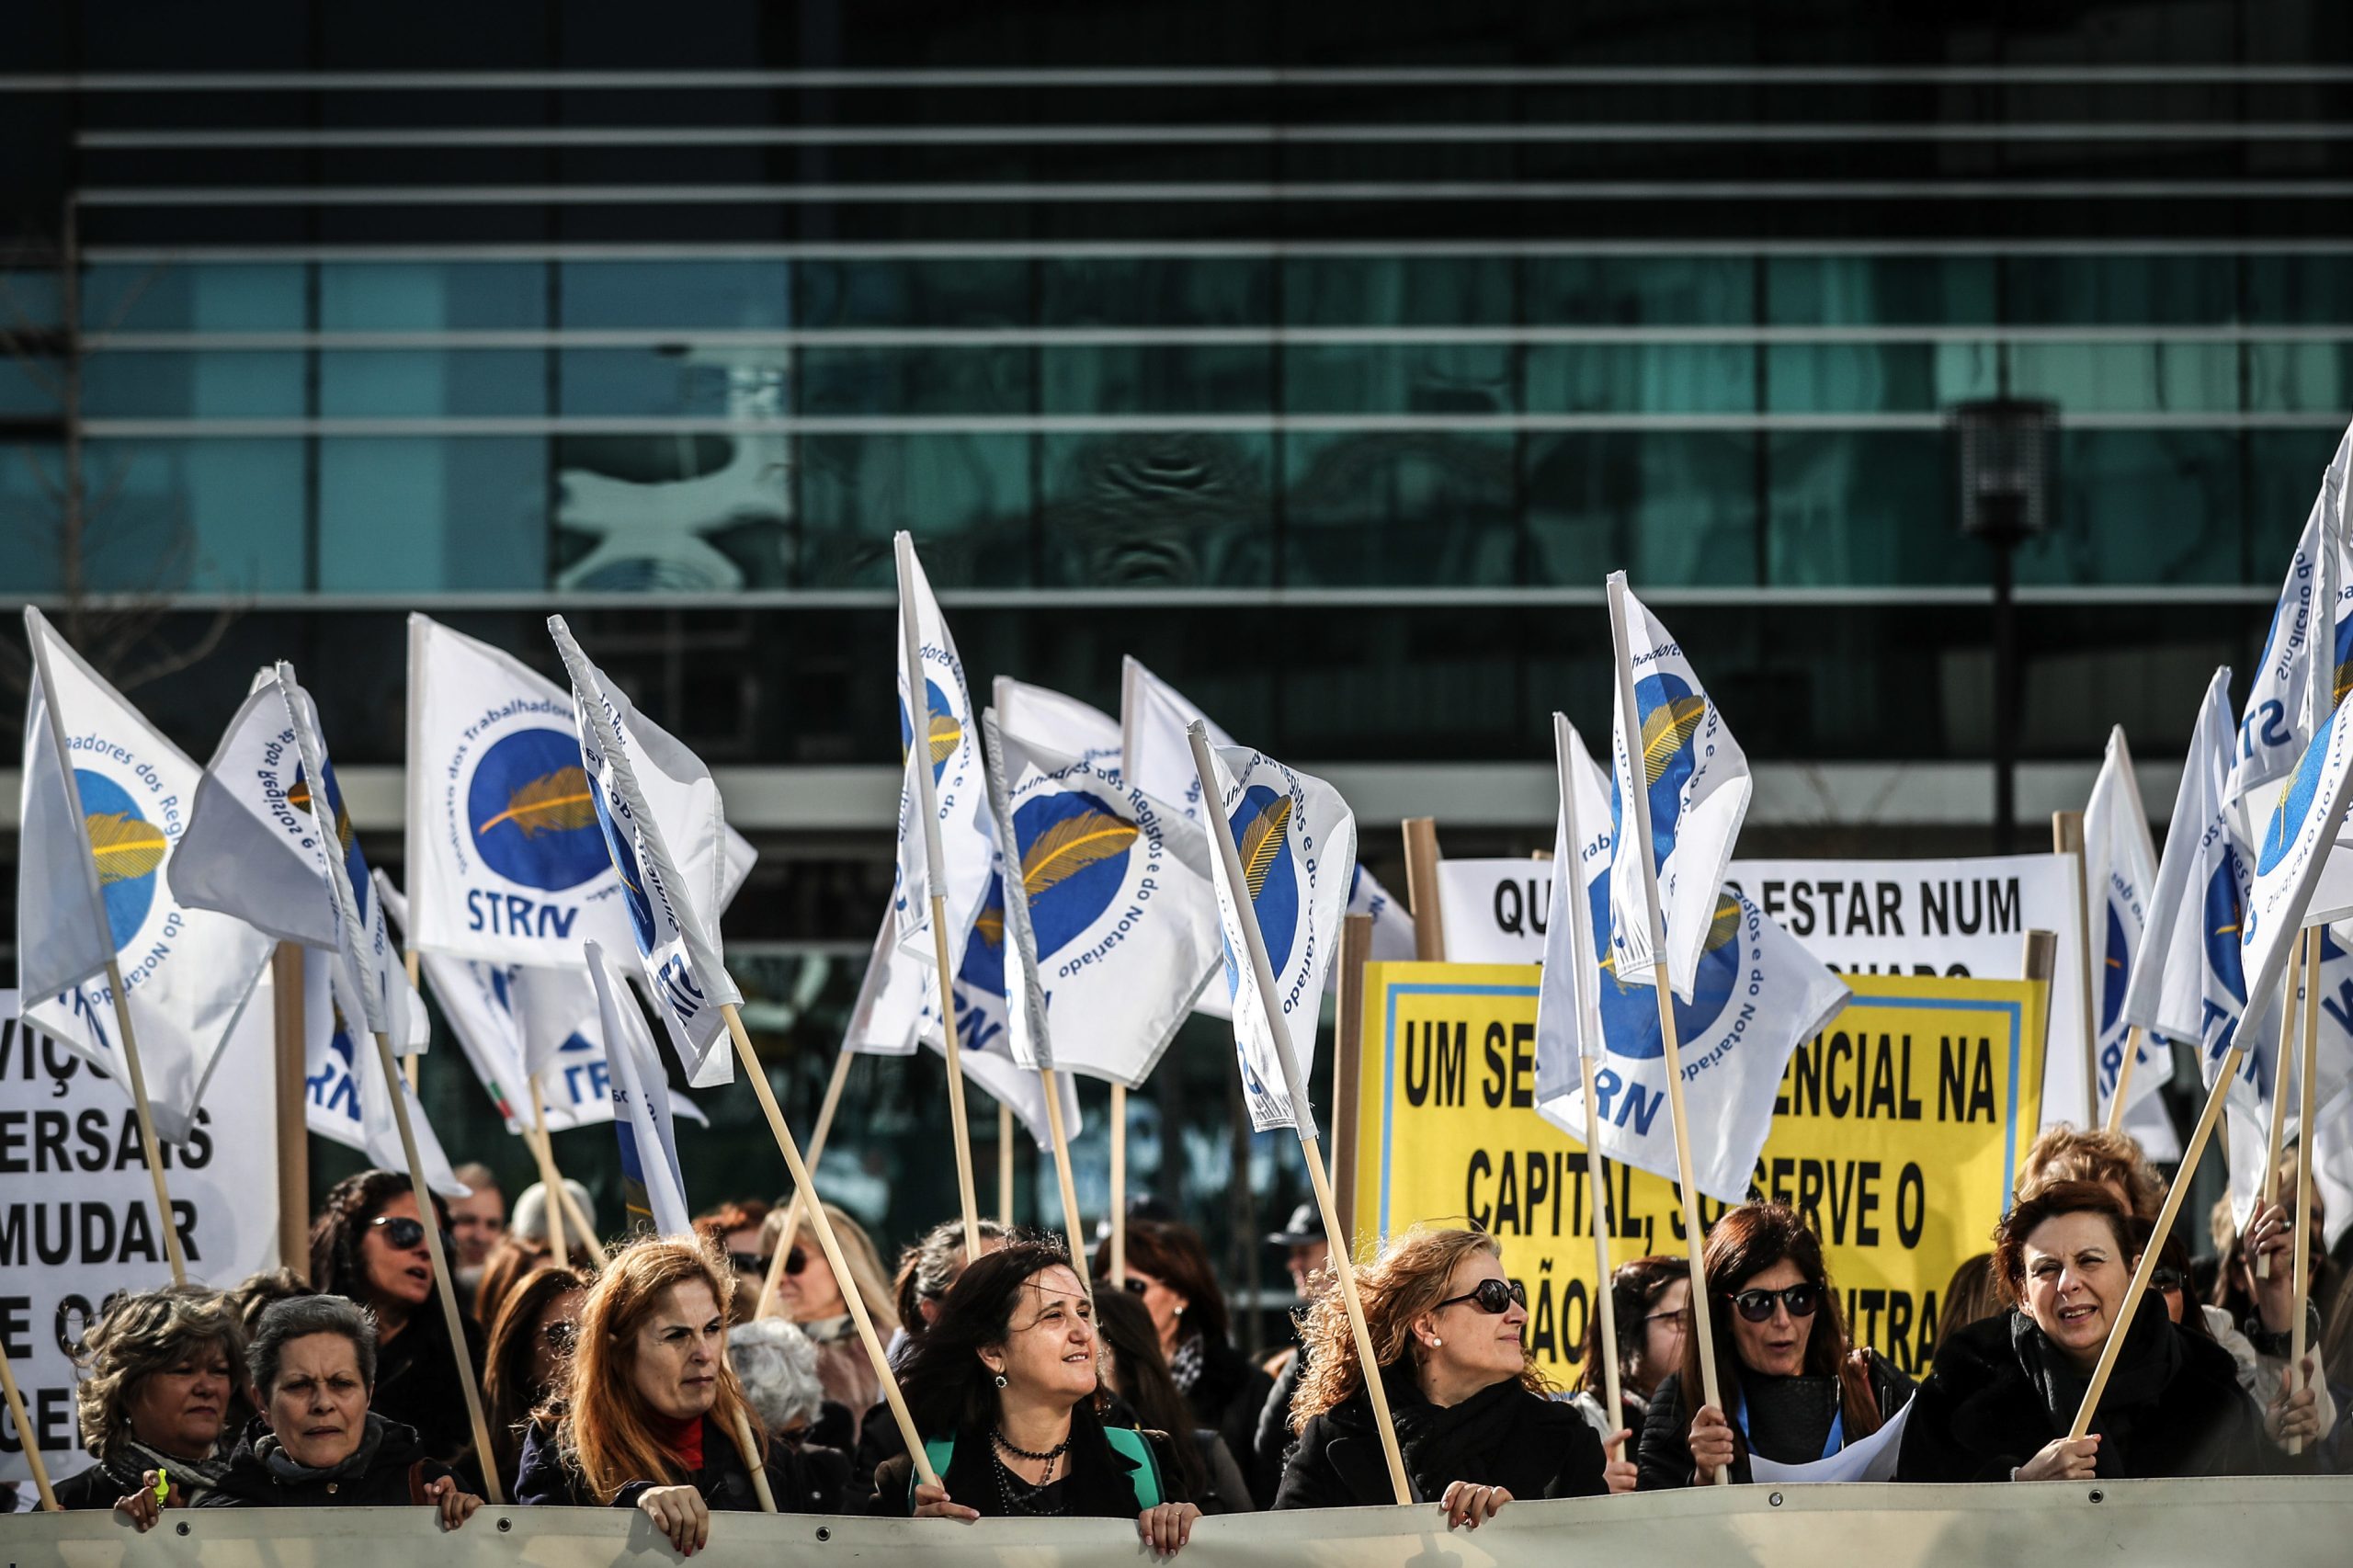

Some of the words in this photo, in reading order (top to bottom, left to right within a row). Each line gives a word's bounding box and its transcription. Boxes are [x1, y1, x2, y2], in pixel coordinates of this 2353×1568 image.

[135, 763, 165, 792] dos
[164, 911, 186, 938] do
[1128, 788, 1164, 860] Registos
[1303, 835, 1313, 852] e
[1137, 878, 1159, 902] do
[1305, 858, 1318, 890] do
[468, 888, 579, 937] STRN
[1921, 878, 2021, 936] NUM
[1059, 905, 1144, 979] Notariado
[1748, 971, 1764, 997] do
[1405, 1020, 1468, 1108] UM
[1482, 1021, 1536, 1109] SE
[1938, 1035, 1996, 1123] NA
[1466, 1148, 1654, 1257] CAPITAL,
[1896, 1161, 1926, 1250] O
[1520, 1257, 1588, 1364] ÃO
